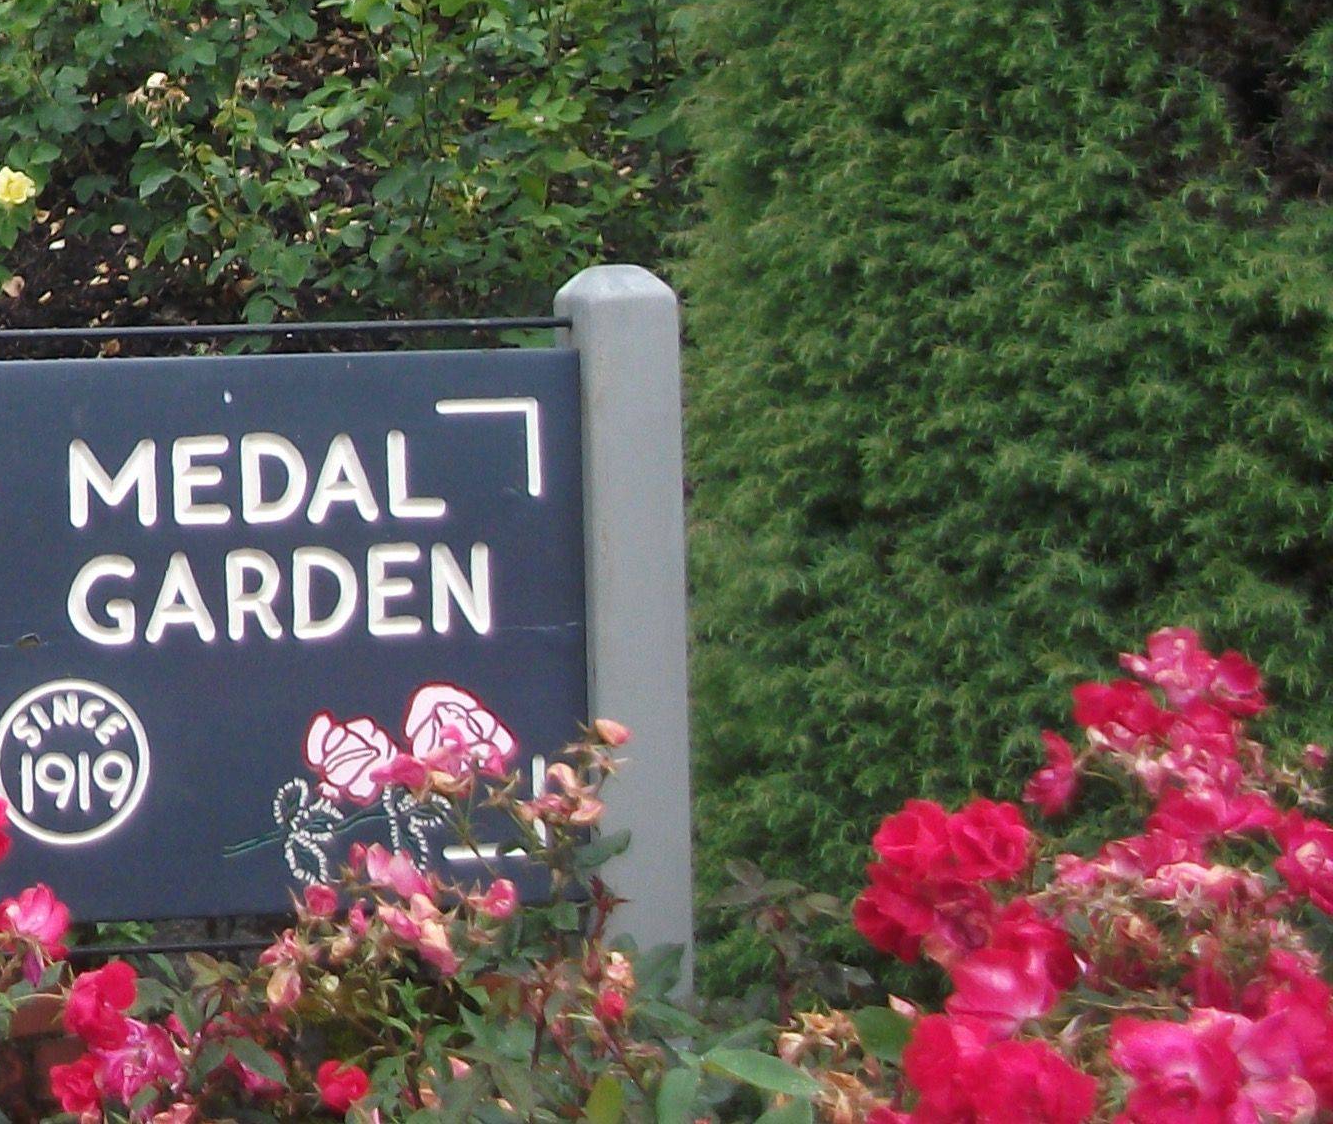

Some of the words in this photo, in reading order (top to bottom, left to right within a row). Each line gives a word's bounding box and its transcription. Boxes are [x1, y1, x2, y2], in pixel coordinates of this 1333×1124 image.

[67, 430, 448, 529] MEDAL
[66, 541, 493, 647] GARDEN
[11, 690, 129, 748] SINCE
[20, 749, 134, 814] 1919
